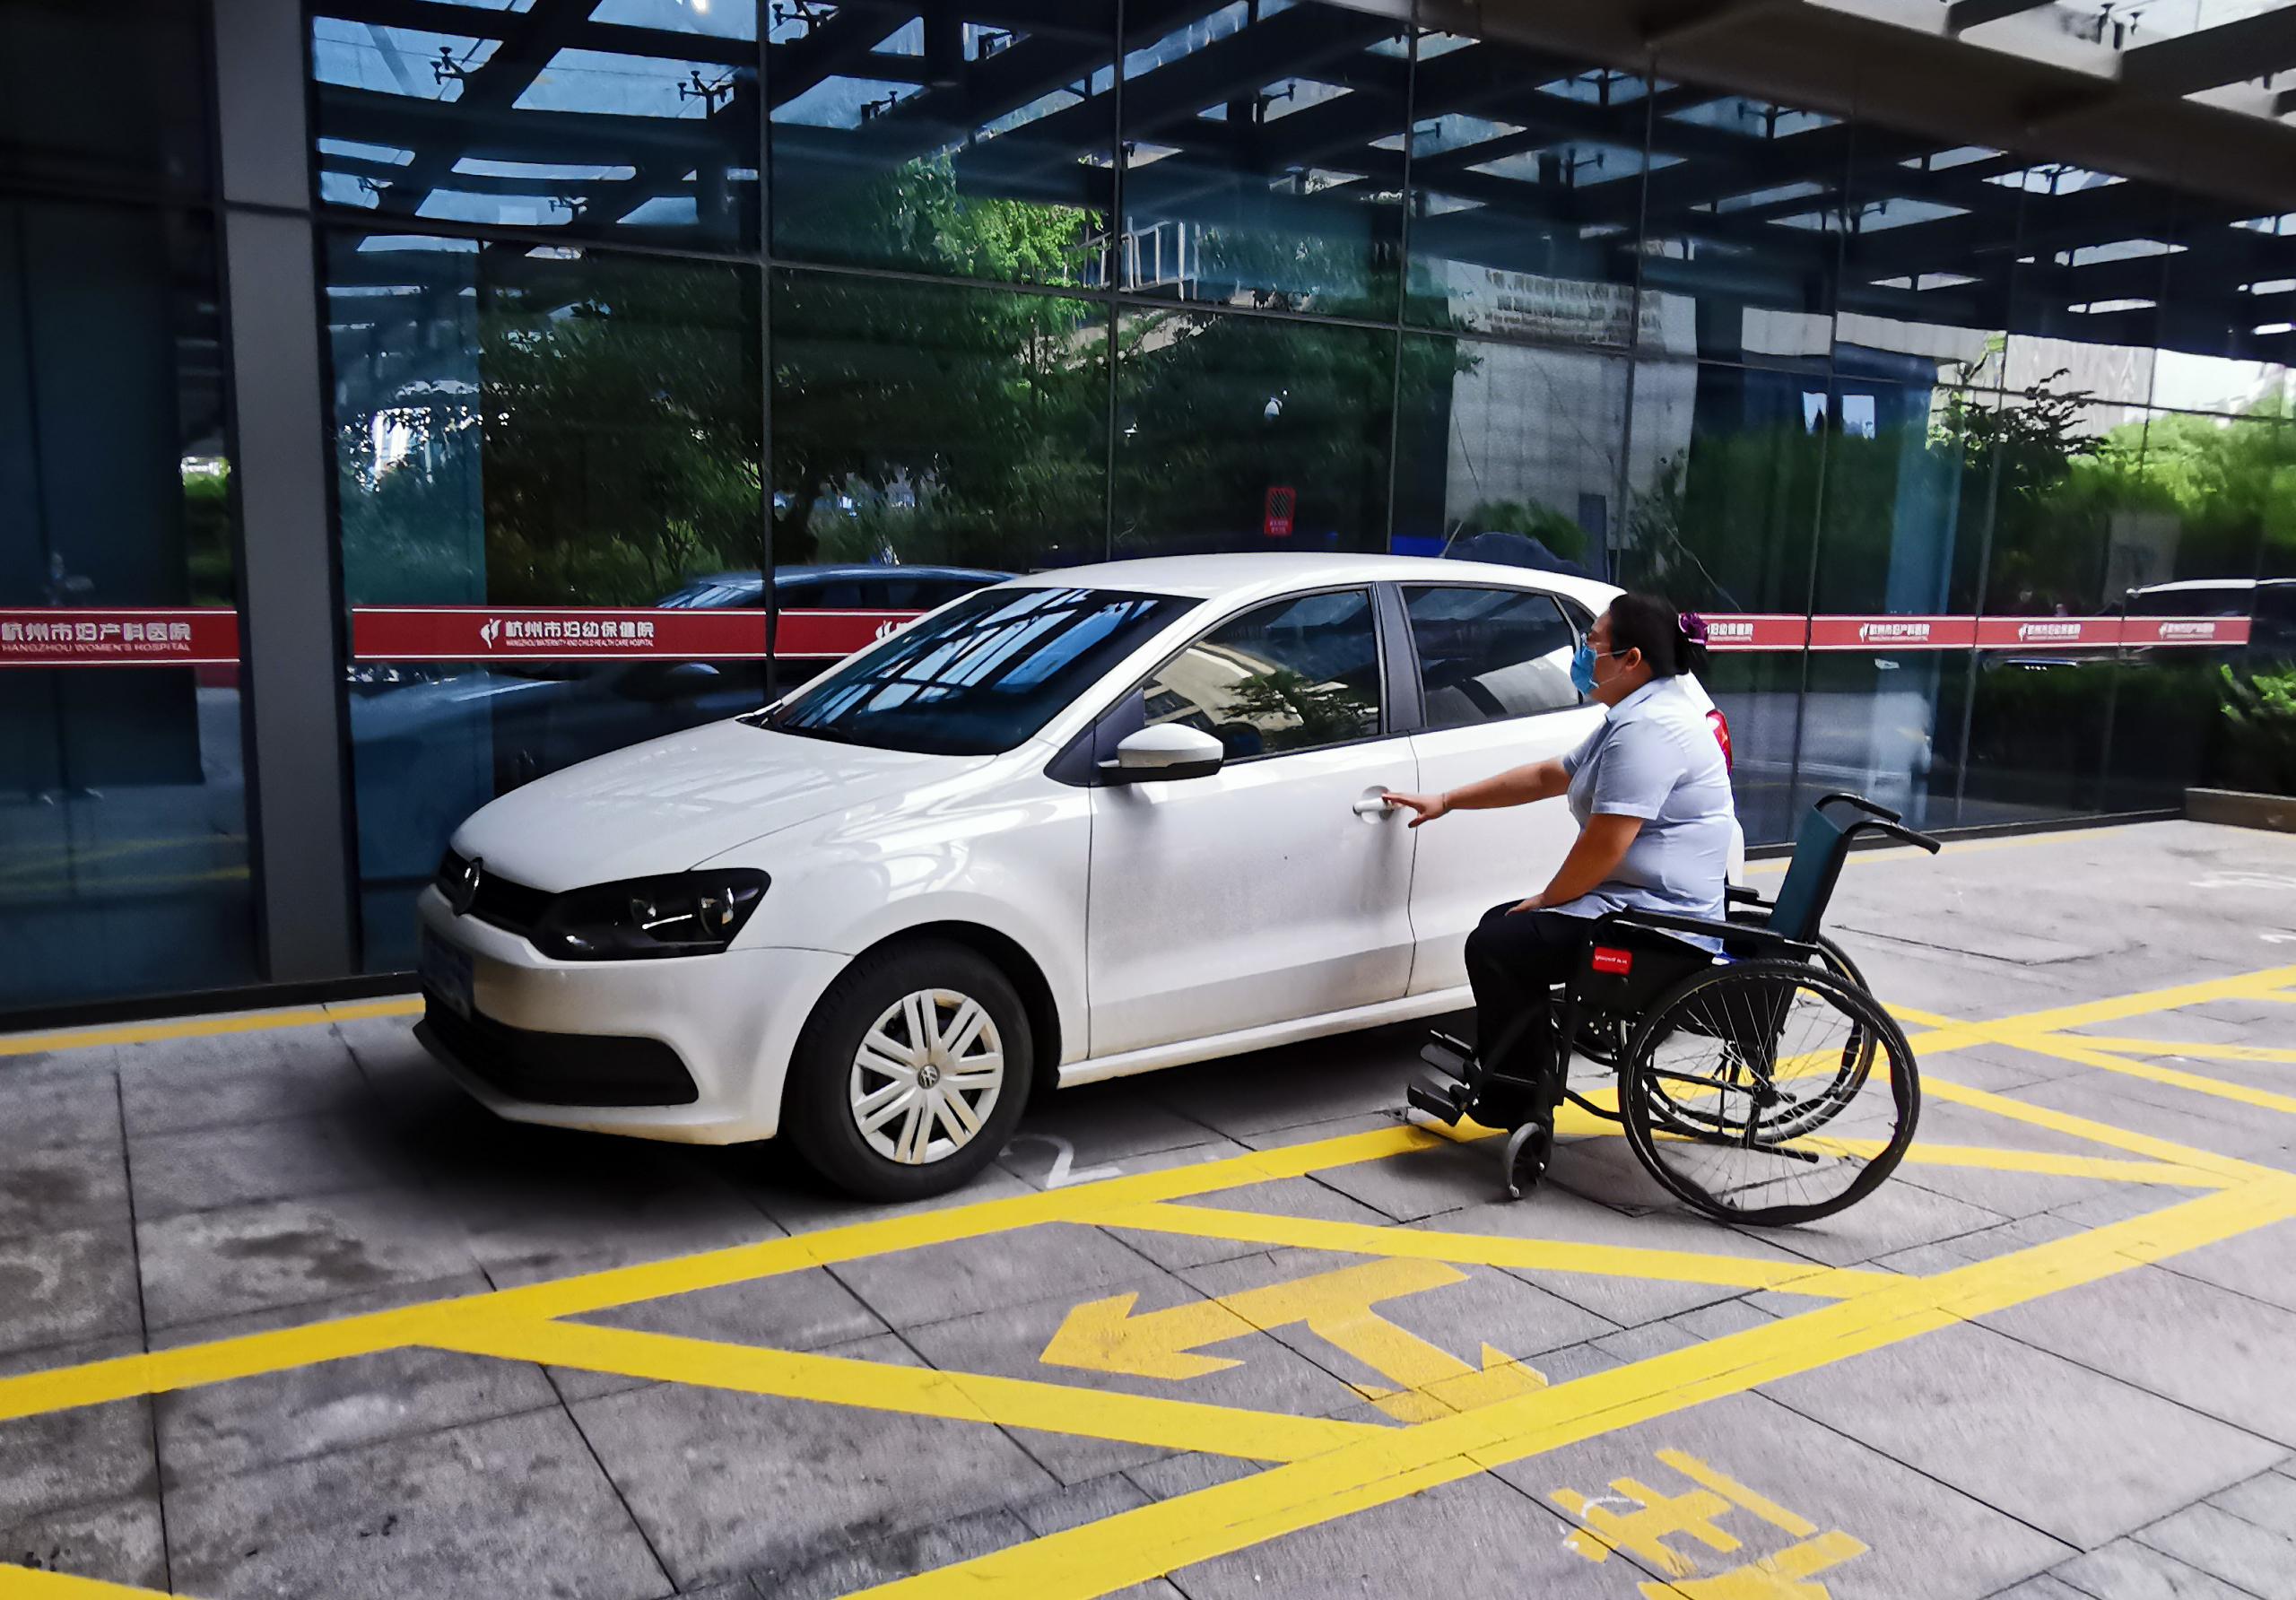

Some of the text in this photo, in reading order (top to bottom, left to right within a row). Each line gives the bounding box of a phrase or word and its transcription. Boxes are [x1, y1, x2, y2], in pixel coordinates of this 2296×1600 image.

[1, 622, 191, 641] 杭州市妇产科医院
[505, 621, 654, 639] 杭州市妇幼保健院
[1, 643, 72, 652] HANGZHOU
[135, 642, 191, 651] HOSPITAL
